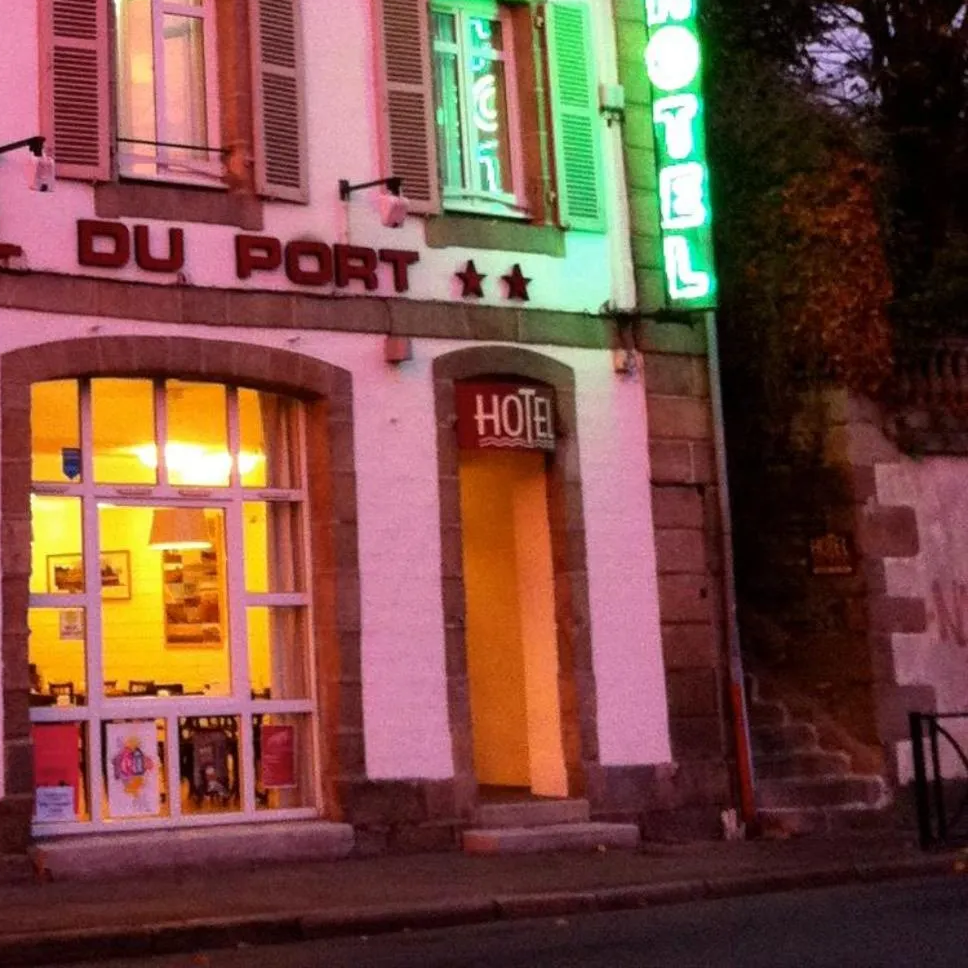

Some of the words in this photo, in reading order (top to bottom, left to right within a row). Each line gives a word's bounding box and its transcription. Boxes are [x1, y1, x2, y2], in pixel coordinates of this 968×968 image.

[77, 218, 184, 273] DU
[235, 234, 420, 292] PORT
[474, 388, 555, 444] HOTEL
